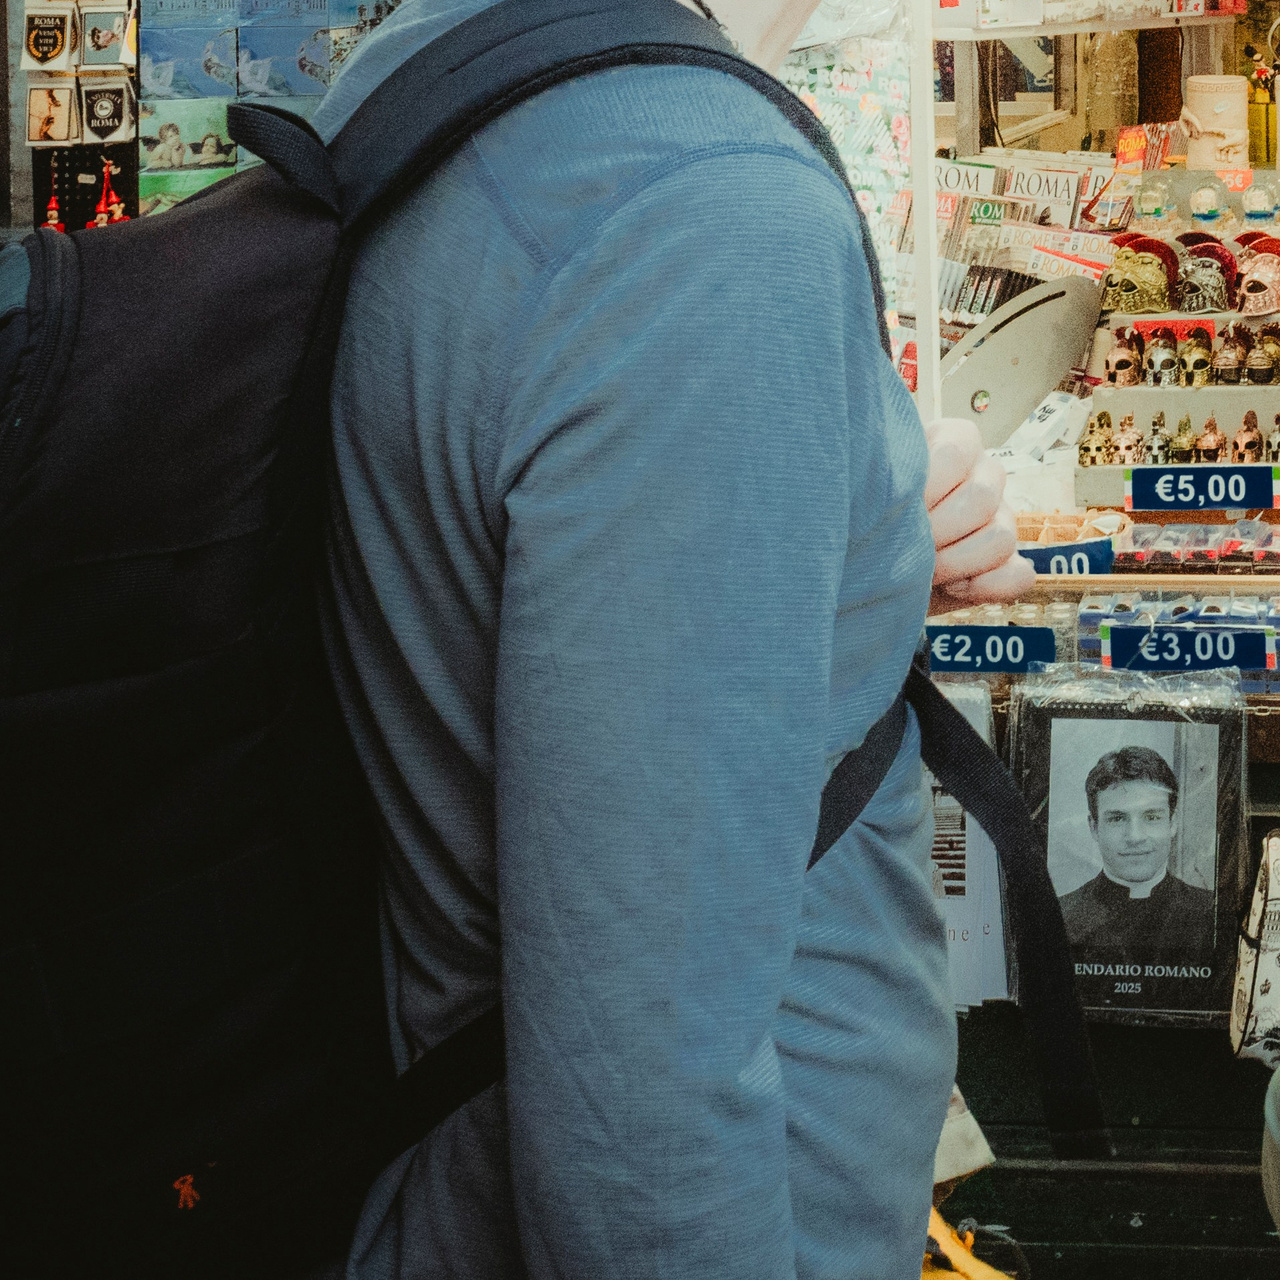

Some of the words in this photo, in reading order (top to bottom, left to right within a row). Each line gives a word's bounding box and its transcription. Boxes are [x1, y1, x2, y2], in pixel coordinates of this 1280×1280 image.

[34, 17, 61, 27] ROMA
[90, 119, 119, 129] ROMA
[1118, 138, 1146, 154] ROMA
[1013, 172, 1071, 200] ROMA
[970, 202, 1006, 219] ROM
[1154, 473, 1246, 508] €5,00
[931, 633, 1025, 667] €2,00
[1140, 631, 1235, 666] €3,00
[1074, 963, 1142, 977] ENDARIO
[1143, 965, 1212, 979] ROMANO
[1113, 982, 1142, 994] 2025
